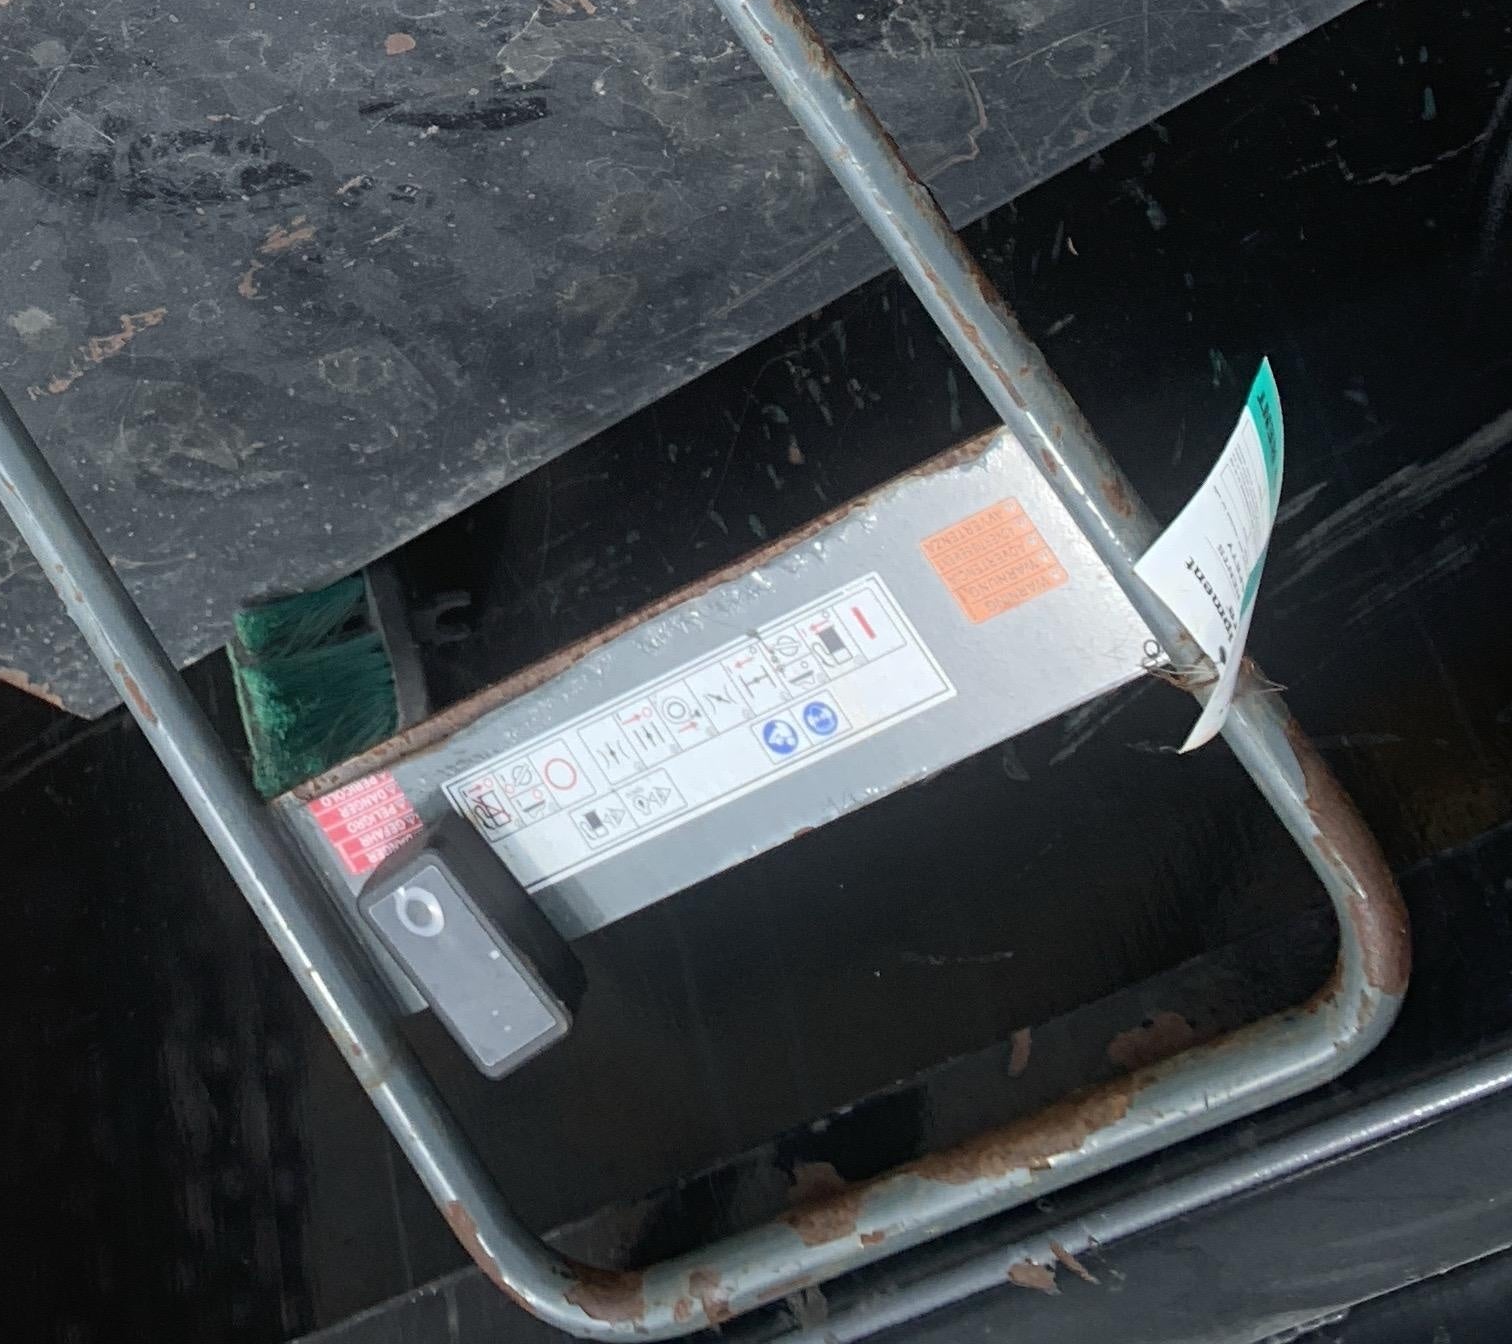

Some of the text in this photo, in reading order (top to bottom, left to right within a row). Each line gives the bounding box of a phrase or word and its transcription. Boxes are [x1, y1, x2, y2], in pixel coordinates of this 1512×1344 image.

[338, 790, 387, 818] DANGER
[347, 804, 397, 833] PELIGRO
[360, 819, 407, 847] GEFAHR
